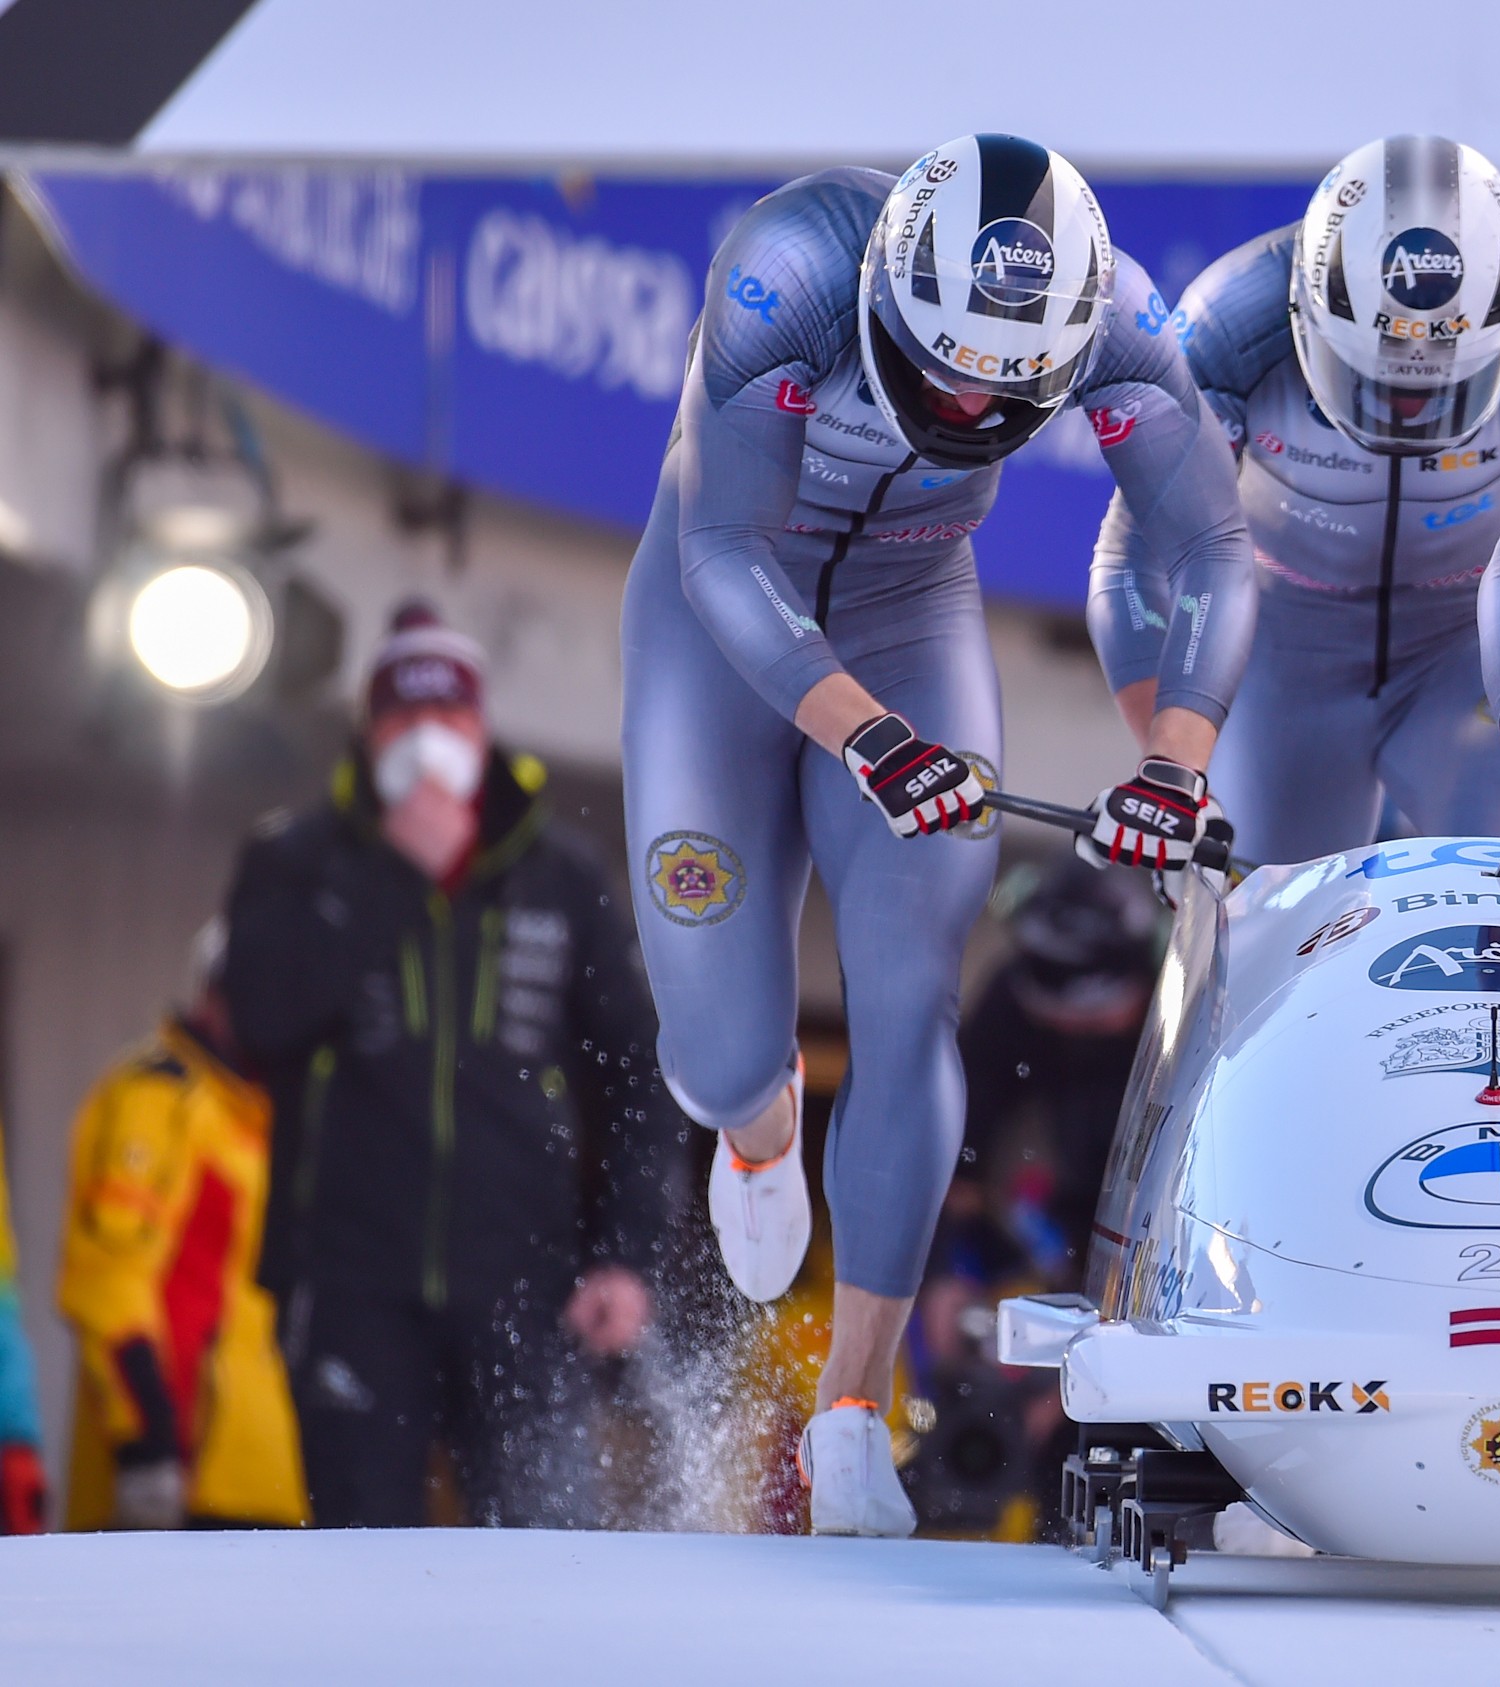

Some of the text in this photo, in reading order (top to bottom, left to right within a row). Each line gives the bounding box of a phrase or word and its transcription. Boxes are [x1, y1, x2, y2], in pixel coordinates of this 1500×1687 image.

[895, 188, 936, 280] Binders
[726, 264, 781, 326] tet
[1373, 313, 1447, 339] RECK
[931, 332, 1026, 377] RECK
[815, 412, 899, 448] Binders
[1286, 444, 1373, 474] Binders
[1419, 447, 1498, 472] RECK
